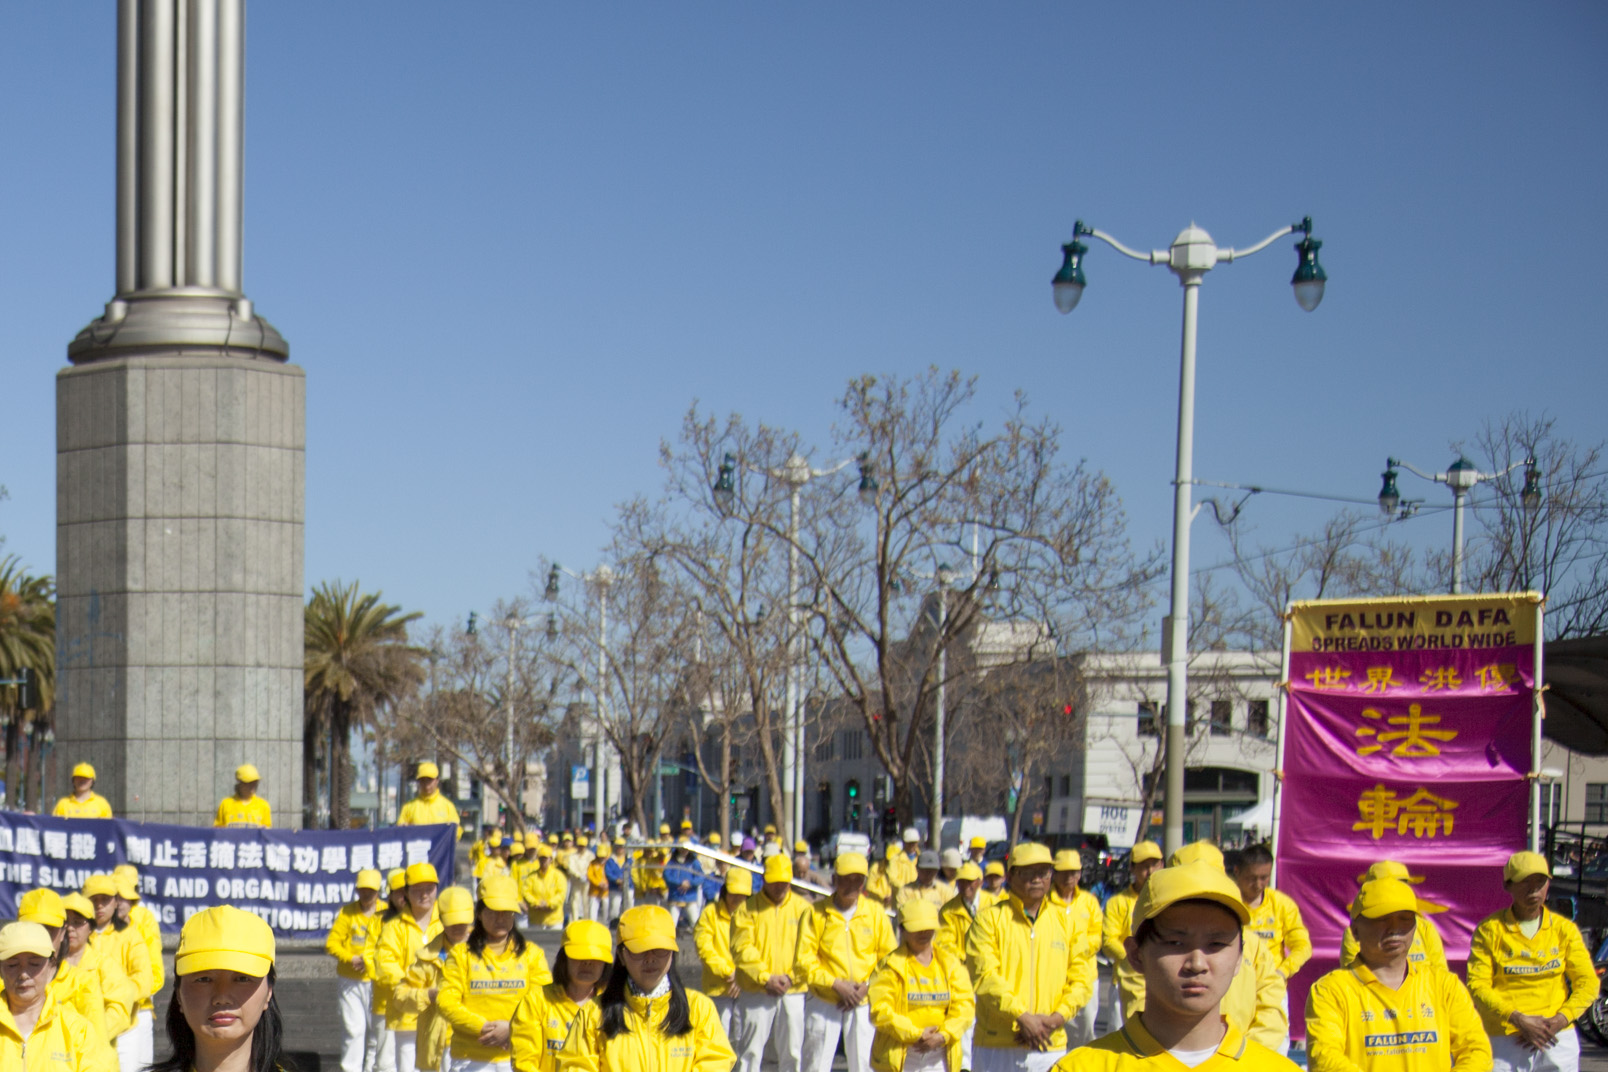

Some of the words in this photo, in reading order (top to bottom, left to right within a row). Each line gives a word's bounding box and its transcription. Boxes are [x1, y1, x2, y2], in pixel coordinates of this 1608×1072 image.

[1325, 611, 1415, 631] FALUN
[1435, 608, 1510, 628] DAFA
[1312, 636, 1392, 652] SPREADS
[1397, 633, 1463, 650] WORLD
[1468, 631, 1516, 648] WIDE
[164, 877, 209, 898] AND
[216, 878, 289, 901] ORGAN
[1368, 1034, 1407, 1046] FALUN
[1411, 1033, 1434, 1043] AFA
